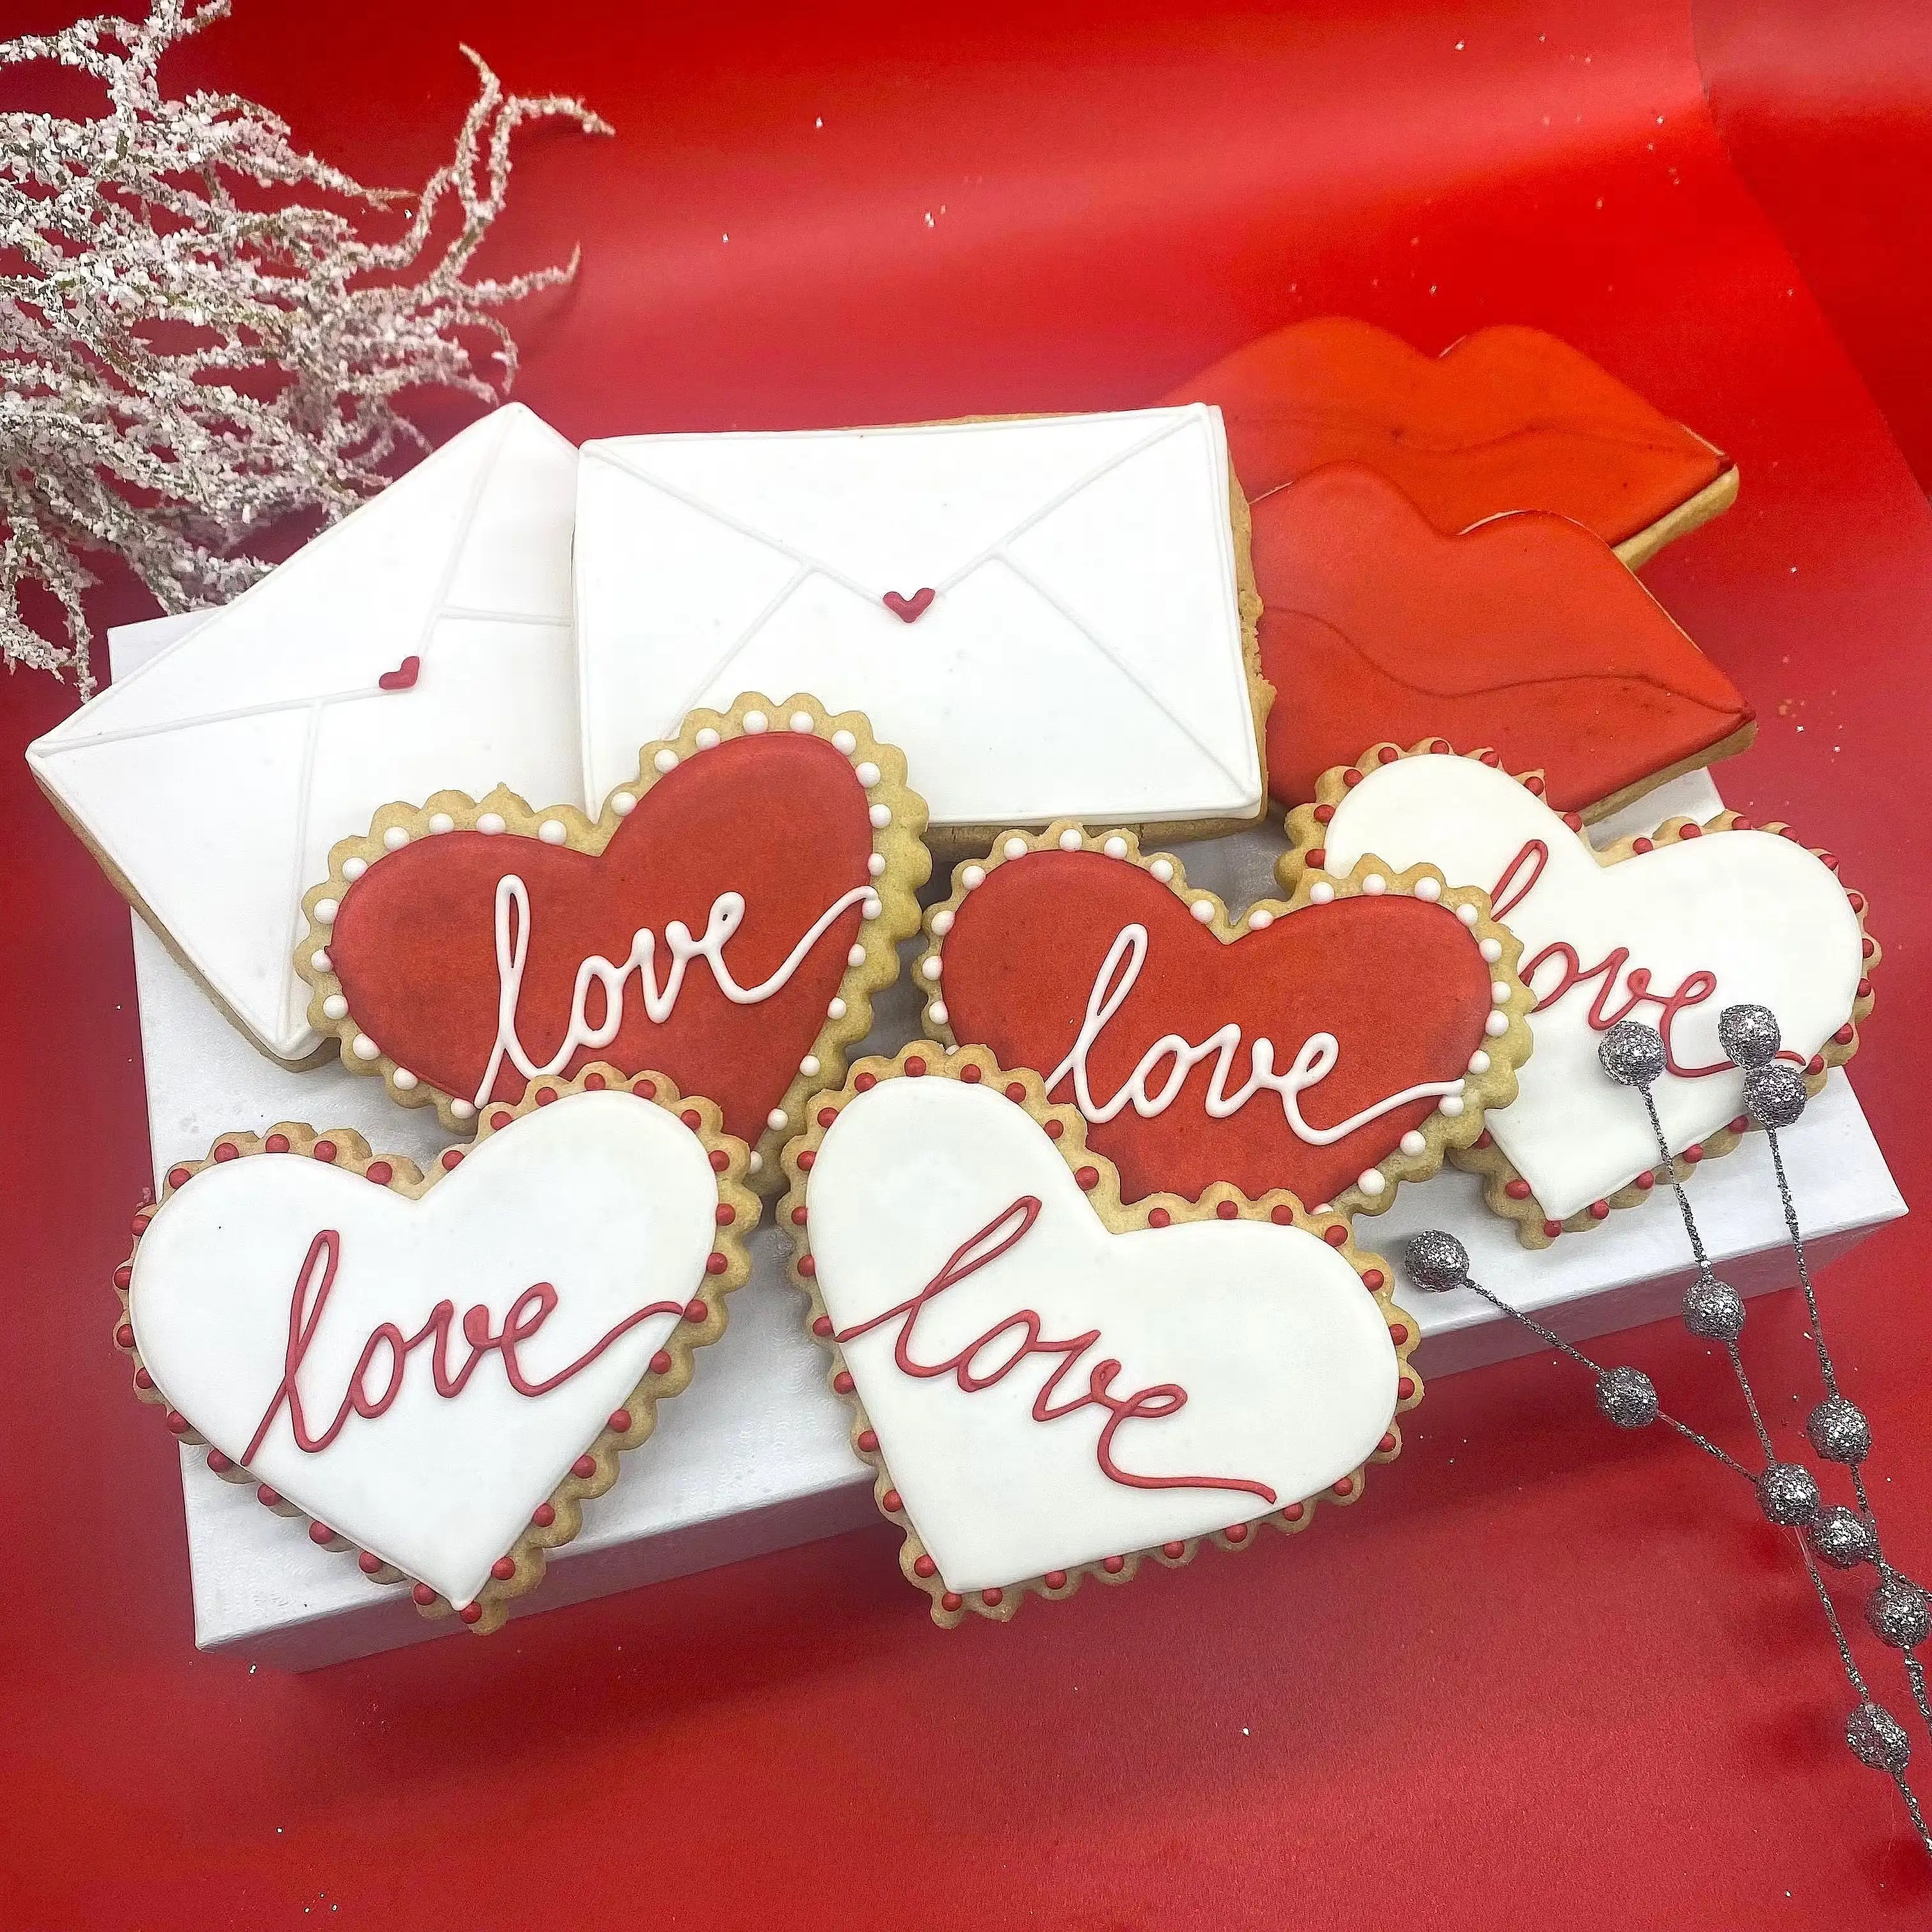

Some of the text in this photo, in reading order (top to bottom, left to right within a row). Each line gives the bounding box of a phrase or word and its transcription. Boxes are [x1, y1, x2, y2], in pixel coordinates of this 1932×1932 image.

[474, 873, 879, 1109] love
[1045, 923, 1466, 1146] love
[240, 1229, 684, 1466] love
[834, 1195, 1277, 1505] love
